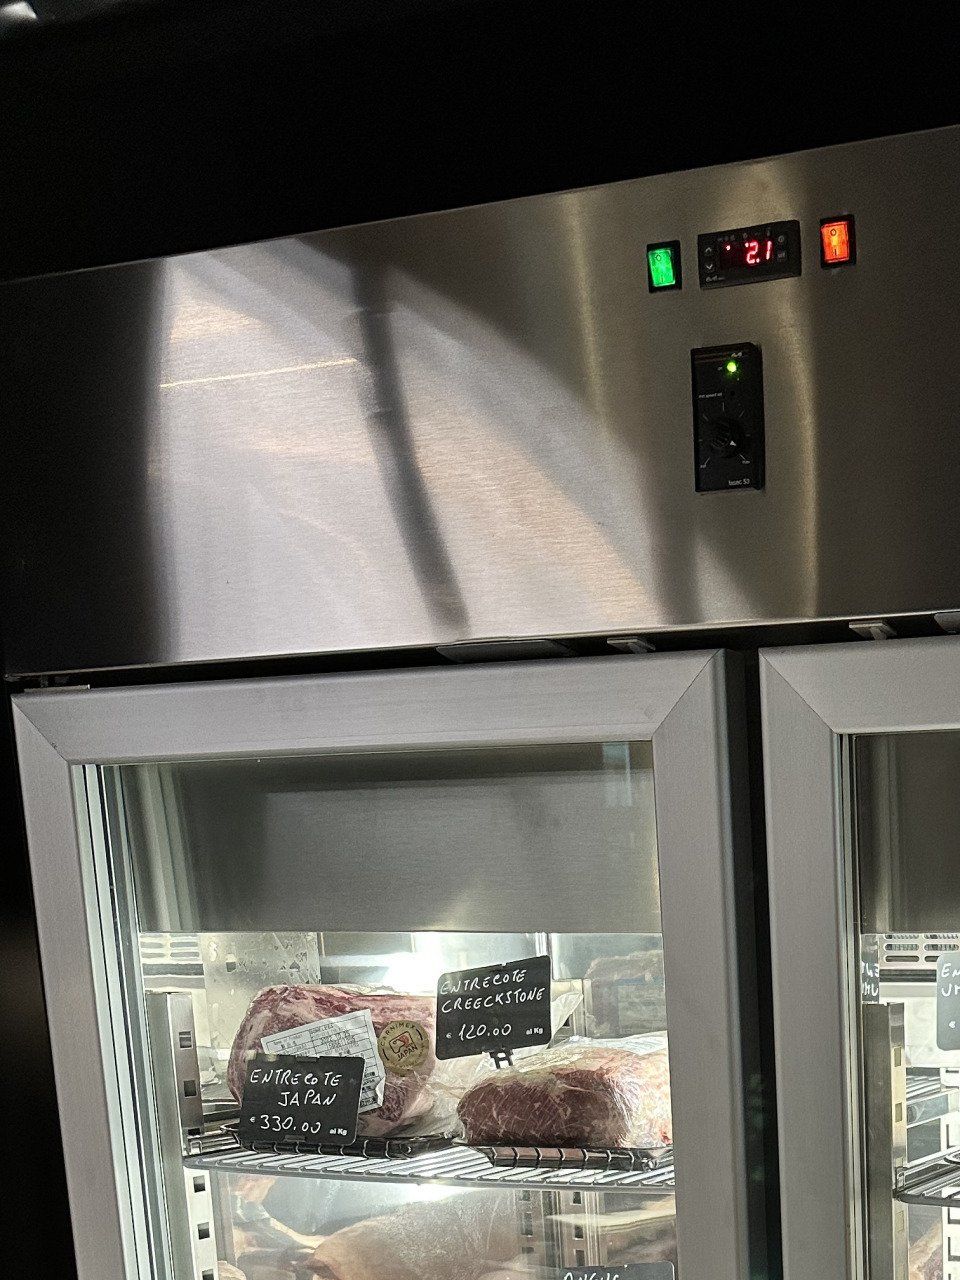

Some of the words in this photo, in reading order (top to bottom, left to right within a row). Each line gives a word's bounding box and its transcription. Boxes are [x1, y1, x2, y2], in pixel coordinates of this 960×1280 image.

[440, 968, 527, 995] ENTRECOTE
[441, 987, 546, 1013] CREECKSTONE
[458, 1023, 513, 1042] 120.00
[249, 1069, 343, 1088] ENTRECOTE
[277, 1088, 338, 1108] JAPAN
[338, 1127, 348, 1137] Kg
